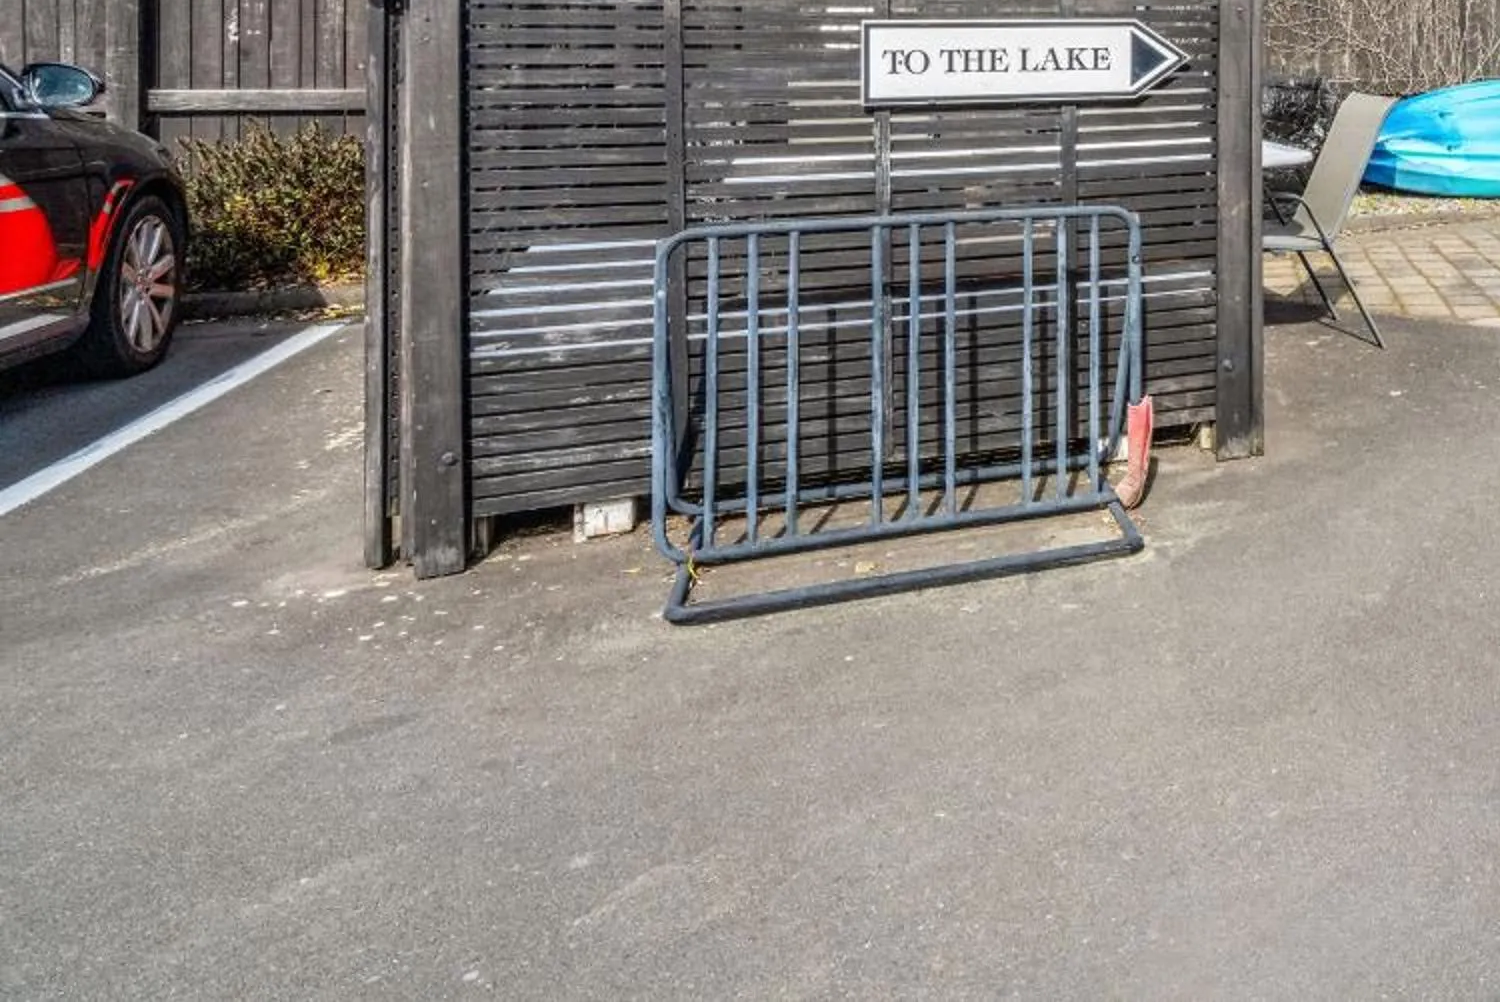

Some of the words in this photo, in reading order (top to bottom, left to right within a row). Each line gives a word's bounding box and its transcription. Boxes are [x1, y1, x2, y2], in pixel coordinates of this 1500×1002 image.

[881, 49, 931, 75] TO
[939, 48, 1009, 73] THE
[1017, 47, 1111, 72] LAKE
